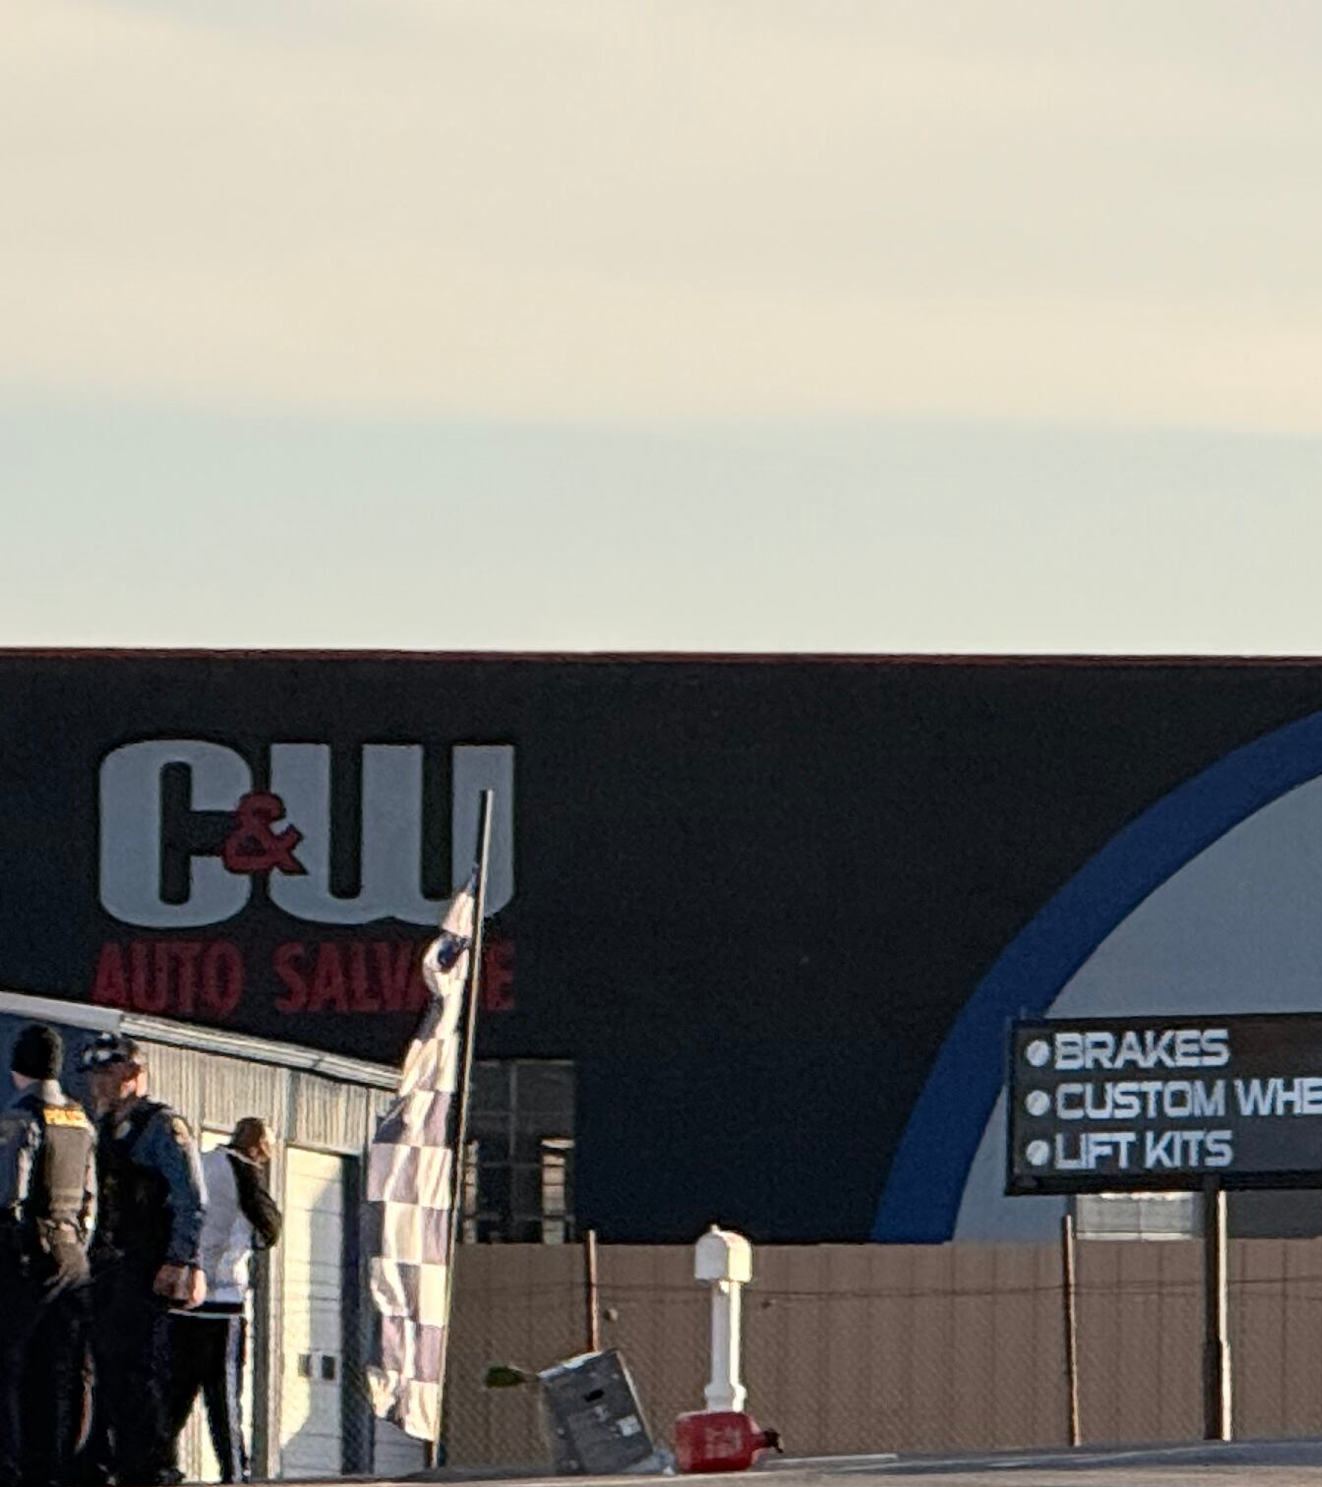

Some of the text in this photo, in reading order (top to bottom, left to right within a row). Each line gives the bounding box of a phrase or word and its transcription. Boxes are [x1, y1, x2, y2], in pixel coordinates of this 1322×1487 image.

[91, 940, 516, 1017] AUTO SALVE
[1054, 1028, 1231, 1070] BRAKES
[1055, 1081, 1226, 1119] CUSTOM
[1055, 1129, 1234, 1169] LIFT KITS
